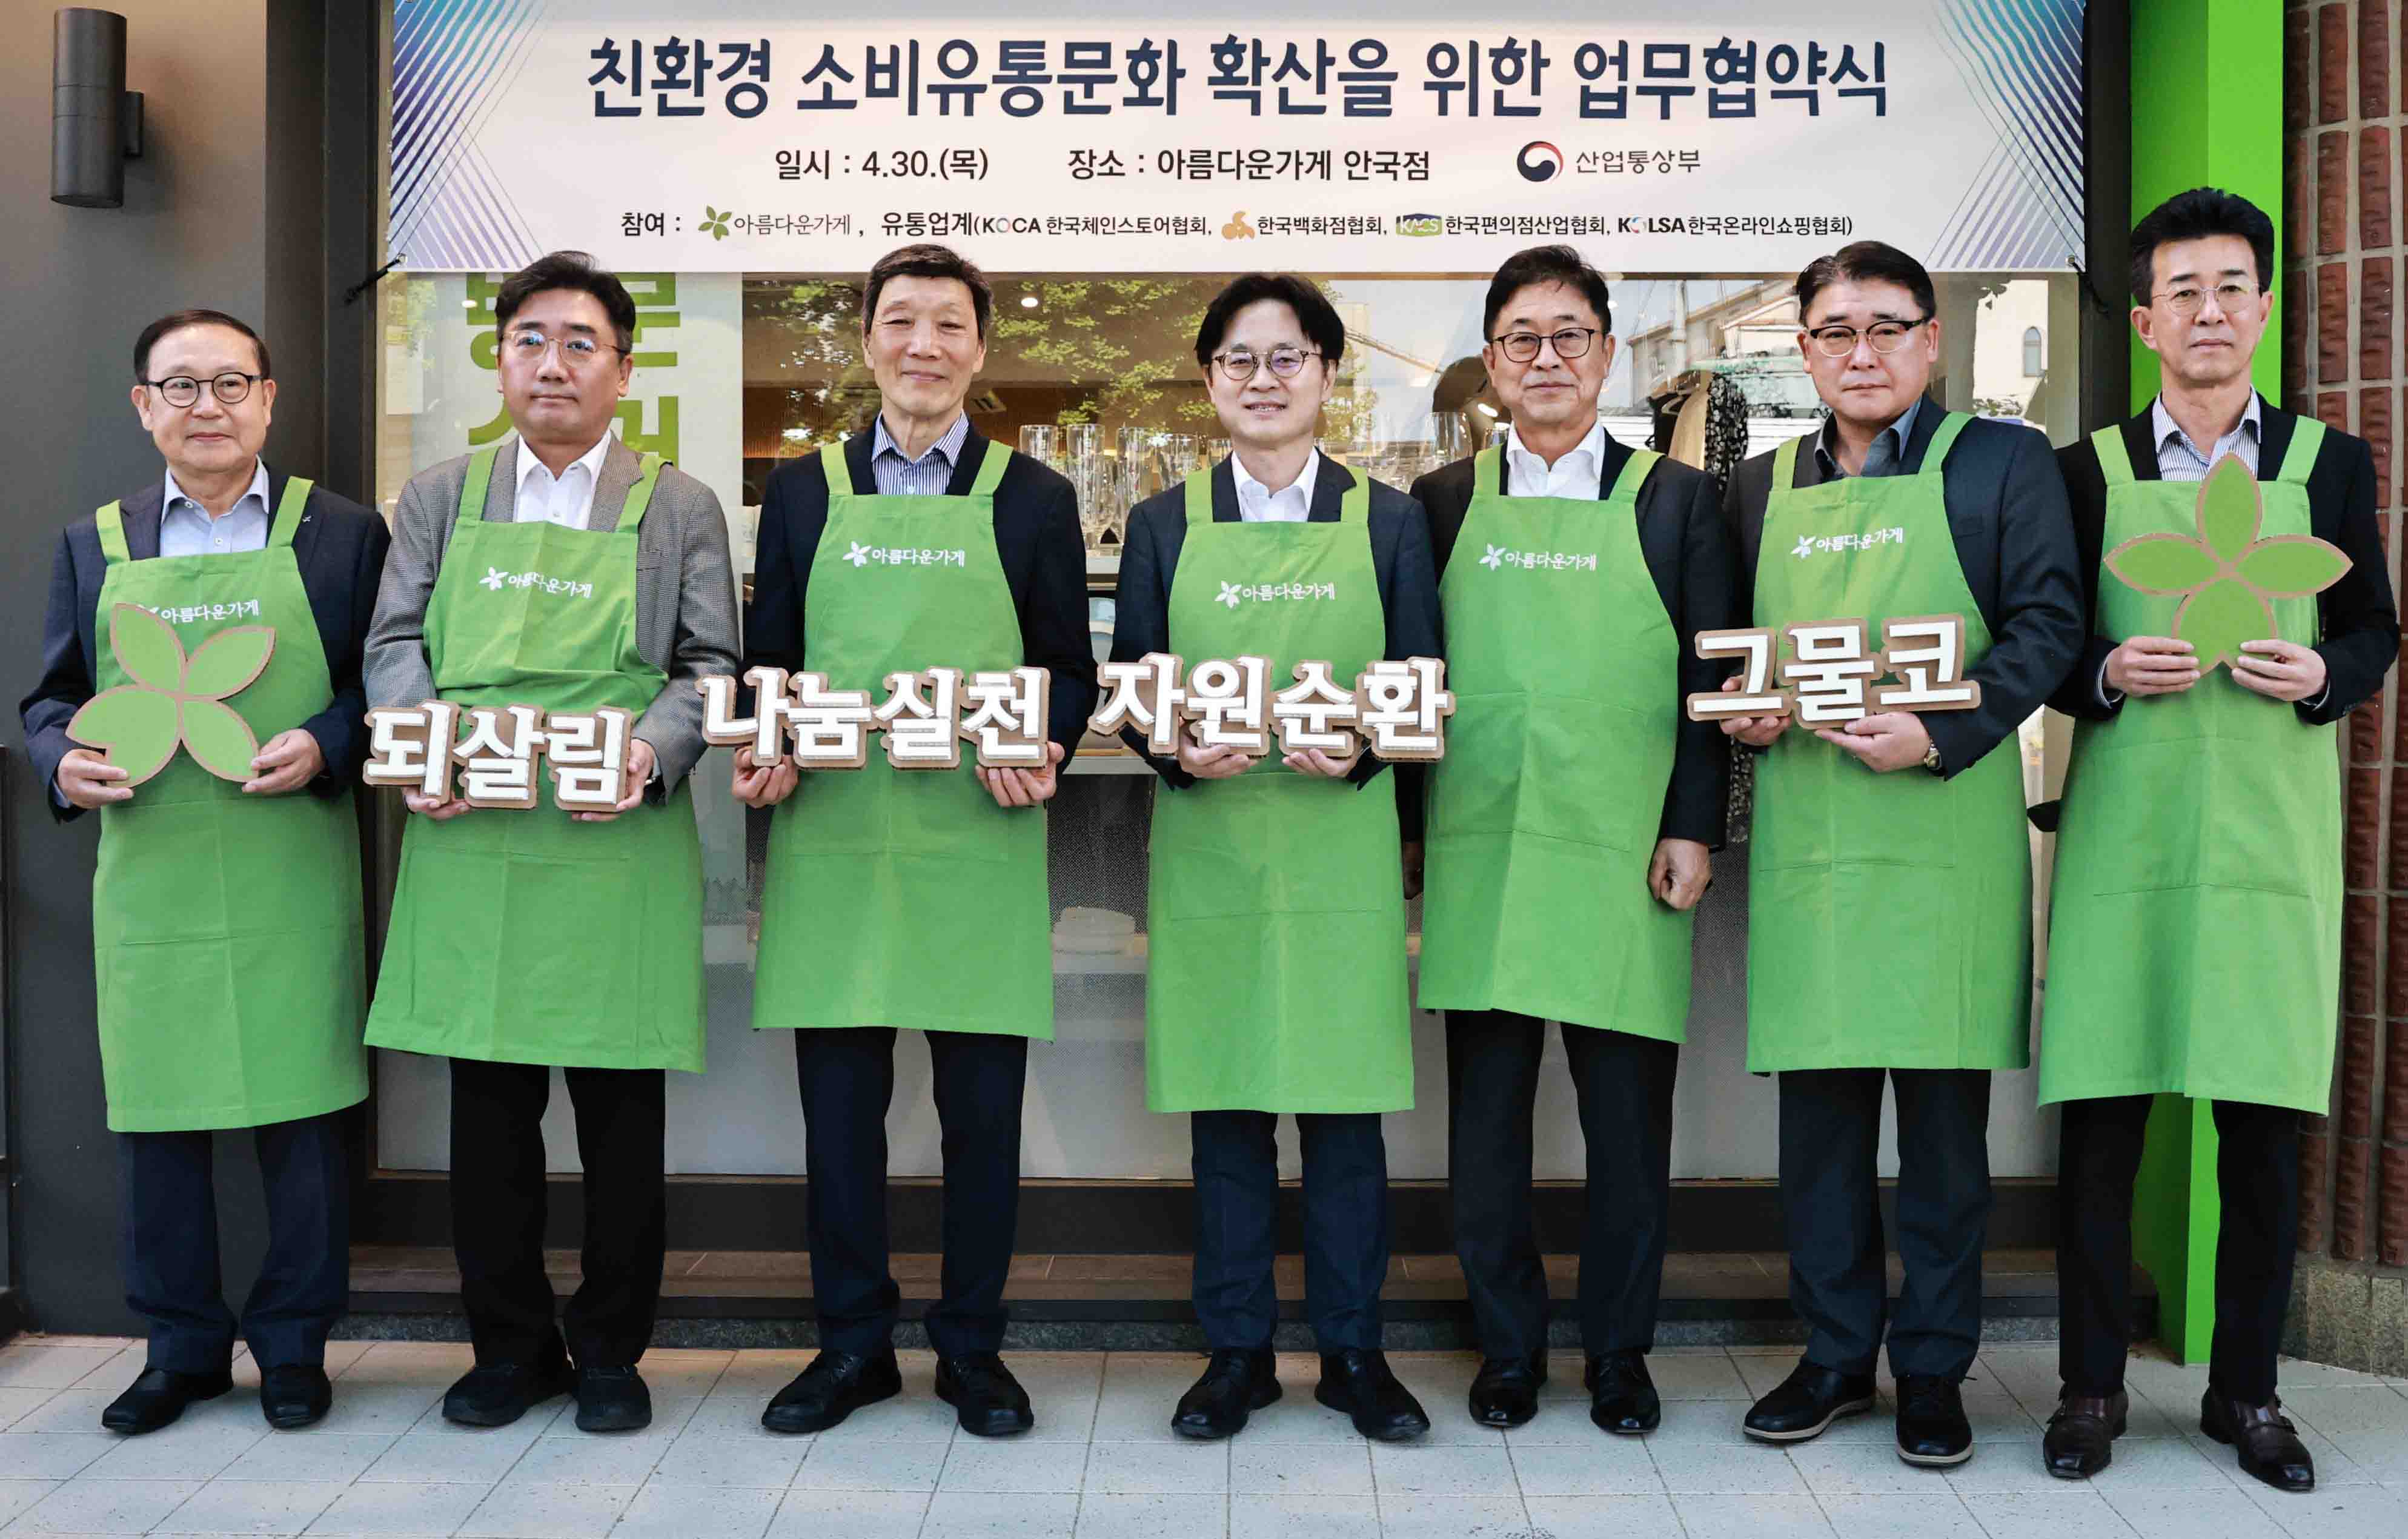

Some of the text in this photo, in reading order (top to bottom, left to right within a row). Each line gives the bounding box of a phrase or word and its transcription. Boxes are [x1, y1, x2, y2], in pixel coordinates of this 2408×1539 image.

[588, 34, 1885, 119] 친환경 소비유통문화 확산을 위한 업무협약식
[776, 150, 829, 180] 일시
[862, 148, 989, 181] 4.30.(목)
[1068, 149, 1126, 180] 장소
[1158, 149, 1331, 181] 아름다운가게
[1344, 150, 1429, 181] 안국점
[1576, 149, 1701, 174] 산업통상부
[621, 212, 665, 236] 참여
[1046, 216, 1212, 236] 한국체인스토어협회,
[1258, 216, 1387, 236] 한국백화점협회,
[1445, 216, 1611, 235] 한국편의점산업협회,
[1815, 527, 1905, 553] 아름다운가게
[871, 548, 965, 568] 아름다운가게
[1505, 550, 1597, 571] 아름다운가게
[508, 571, 593, 599] 아름다운가게
[1242, 582, 1335, 602] 아름다운가게
[161, 599, 259, 624] 아름다운가게
[1693, 620, 1972, 722] 그물코
[702, 668, 1043, 761] 나눔실천
[1095, 653, 1450, 751] 자원순환
[367, 702, 626, 805] 되살림
